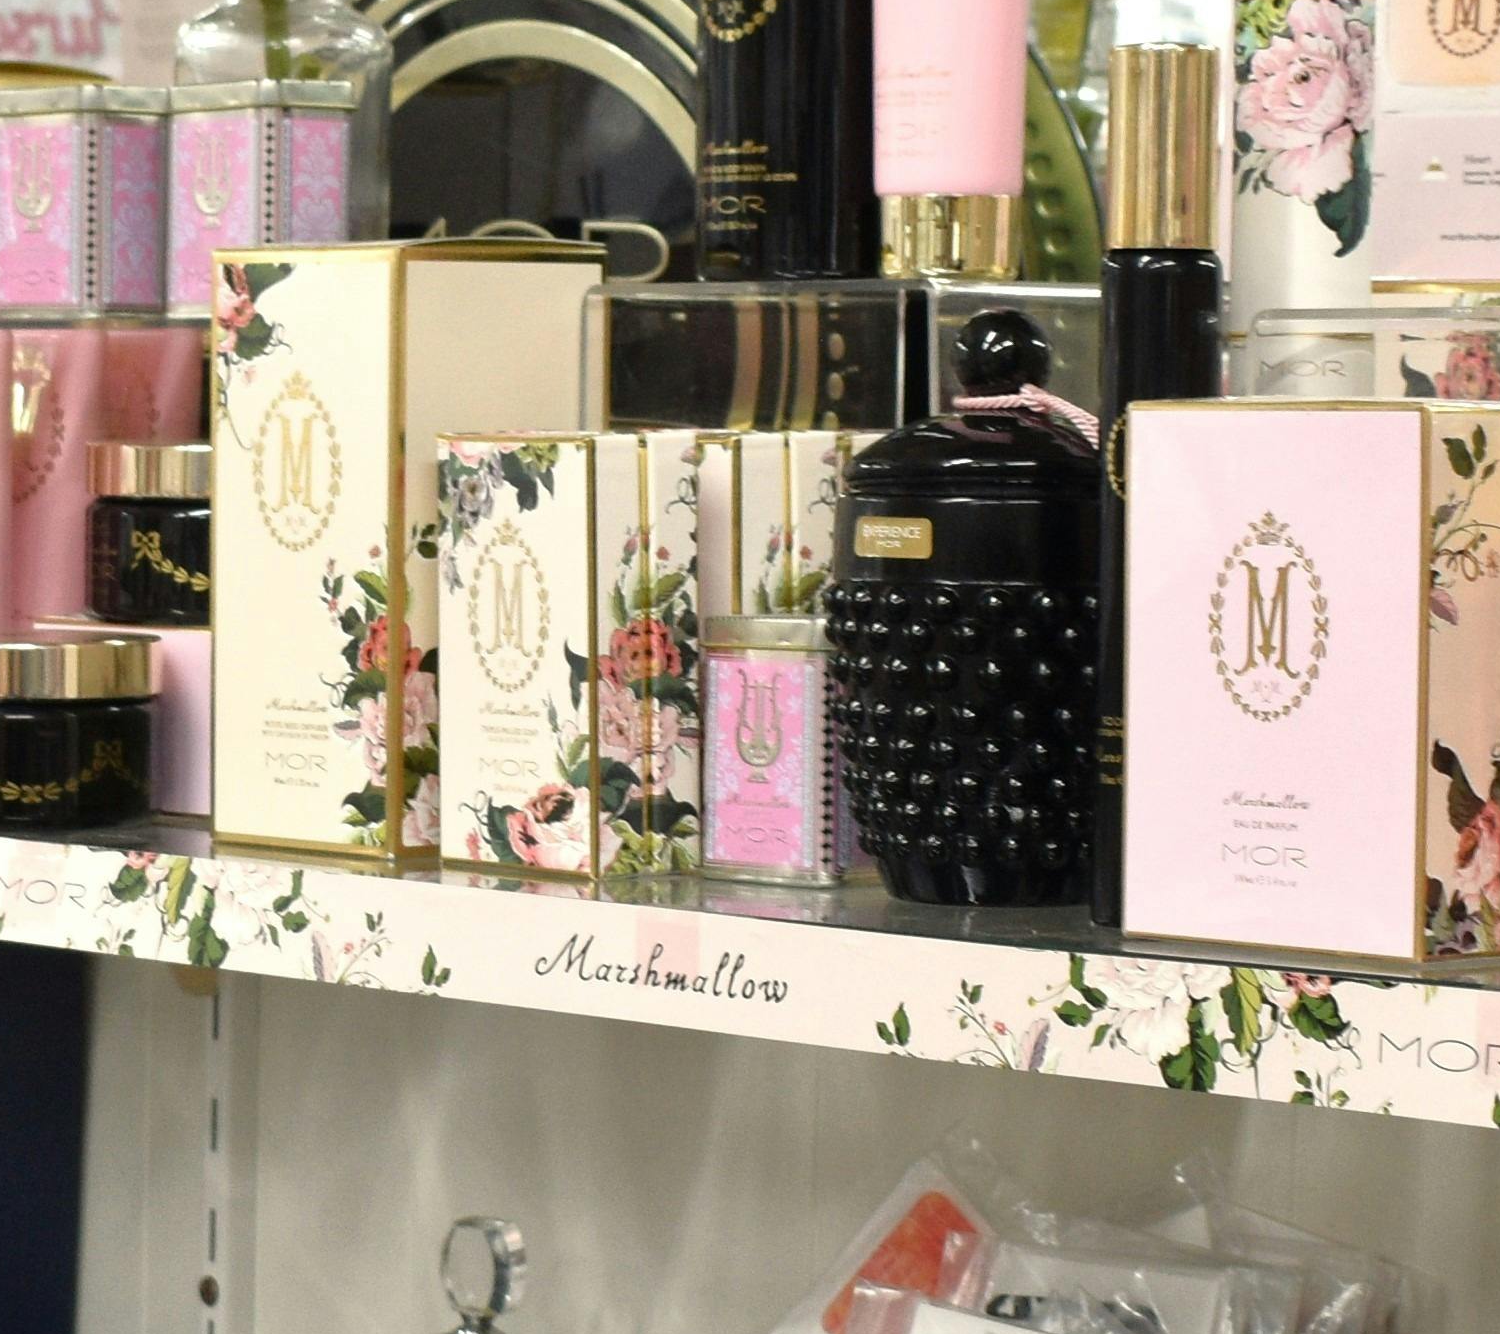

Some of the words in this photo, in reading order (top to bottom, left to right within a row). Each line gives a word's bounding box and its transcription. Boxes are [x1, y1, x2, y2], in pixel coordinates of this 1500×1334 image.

[265, 751, 328, 772] MOR
[479, 757, 541, 780] MOR
[1221, 842, 1309, 868] MOR
[535, 932, 790, 1006] Marshmallow
